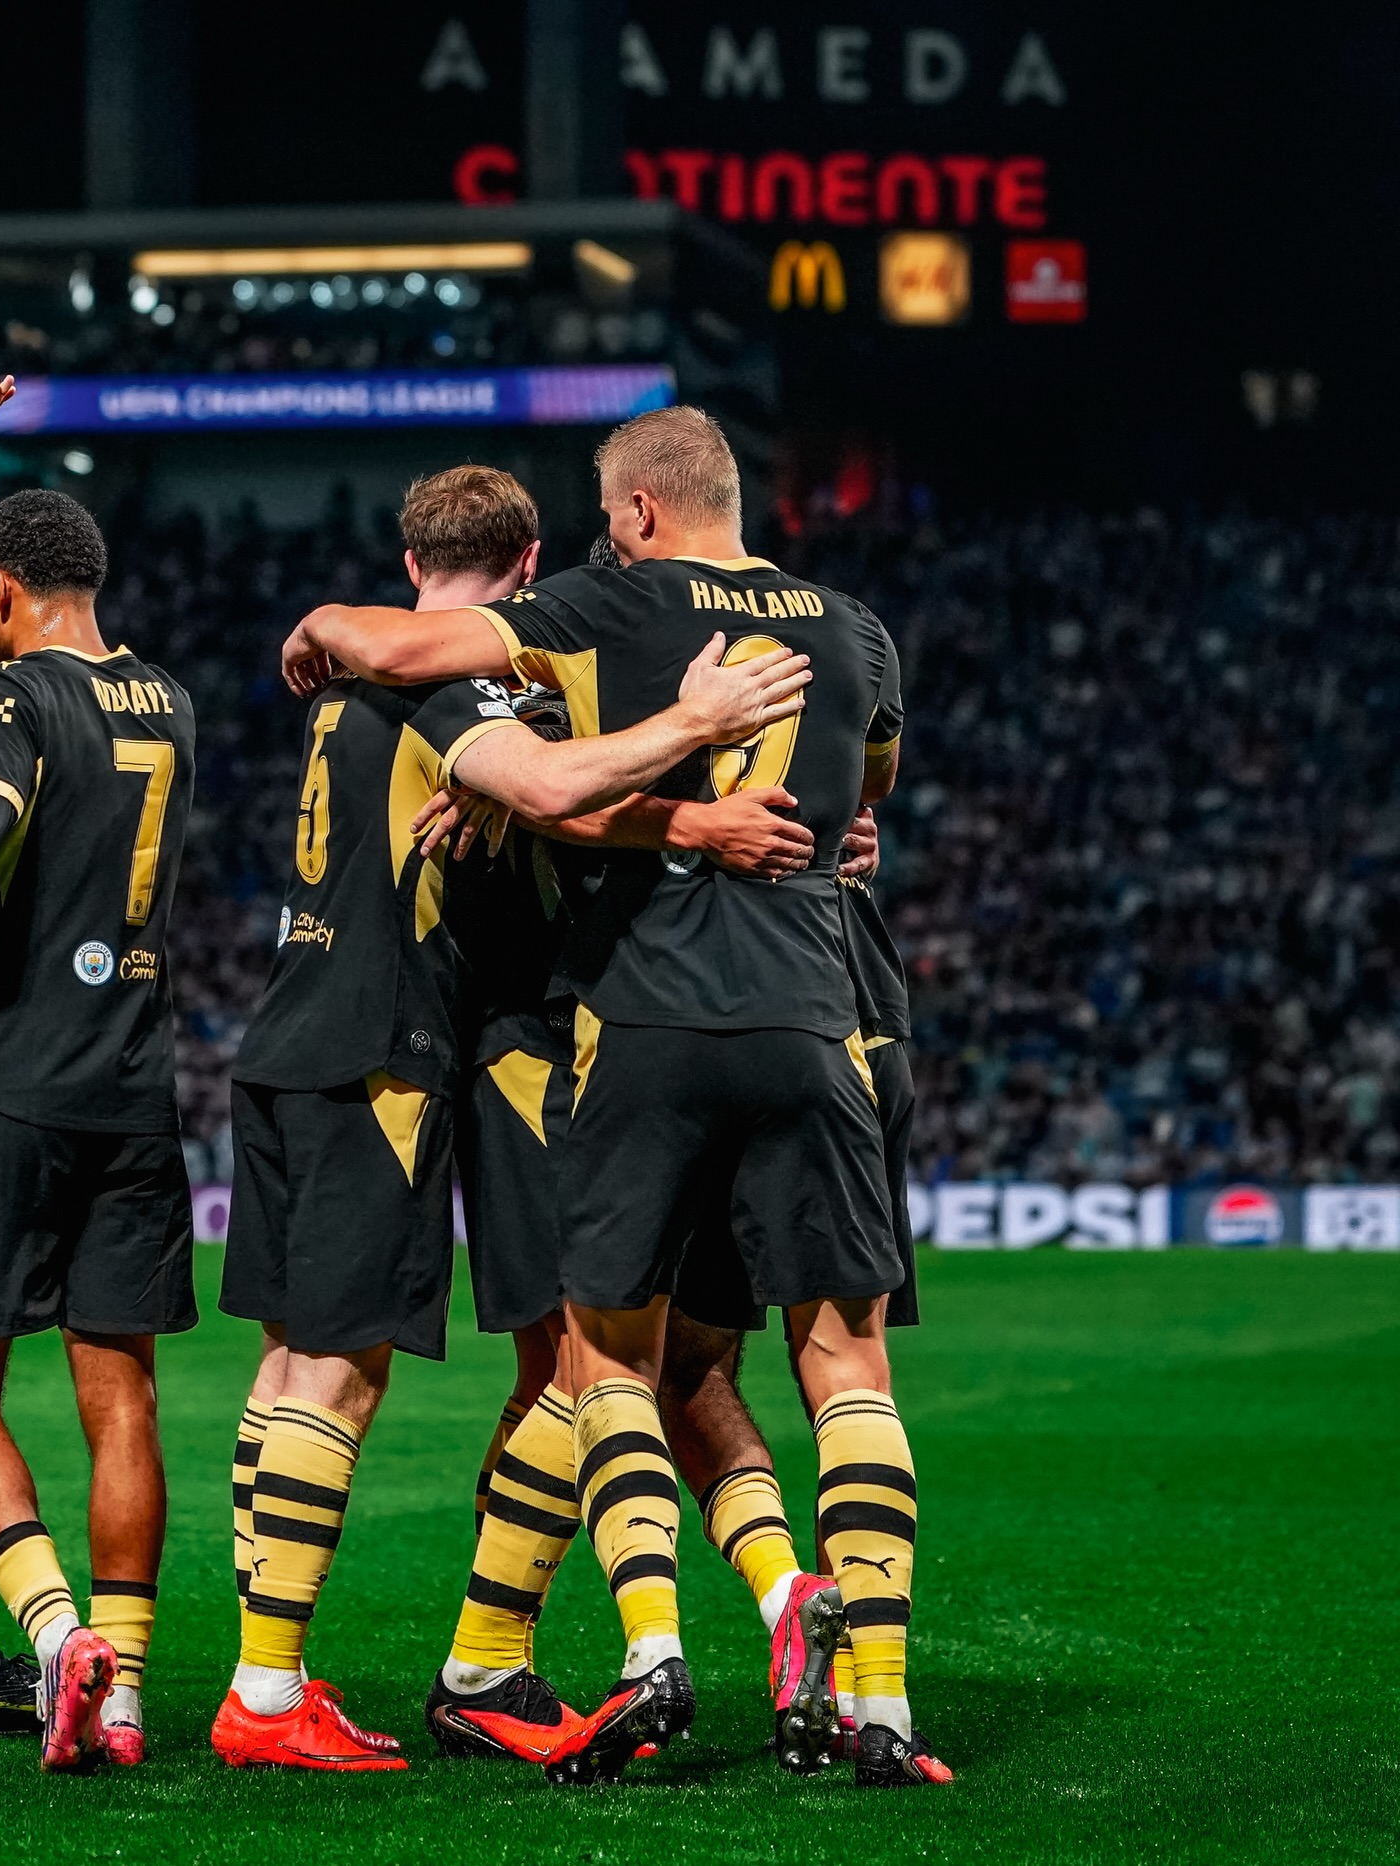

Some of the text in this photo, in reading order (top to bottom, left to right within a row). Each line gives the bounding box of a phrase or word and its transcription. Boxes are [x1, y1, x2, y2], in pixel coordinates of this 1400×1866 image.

[420, 18, 1066, 106] AAMEDA
[452, 145, 1047, 228] CTINENTE
[690, 578, 824, 621] HAALAND
[90, 676, 174, 715] NDIAYE
[113, 737, 176, 927] 7
[78, 943, 111, 958] MANCHESTER
[131, 949, 156, 966] City
